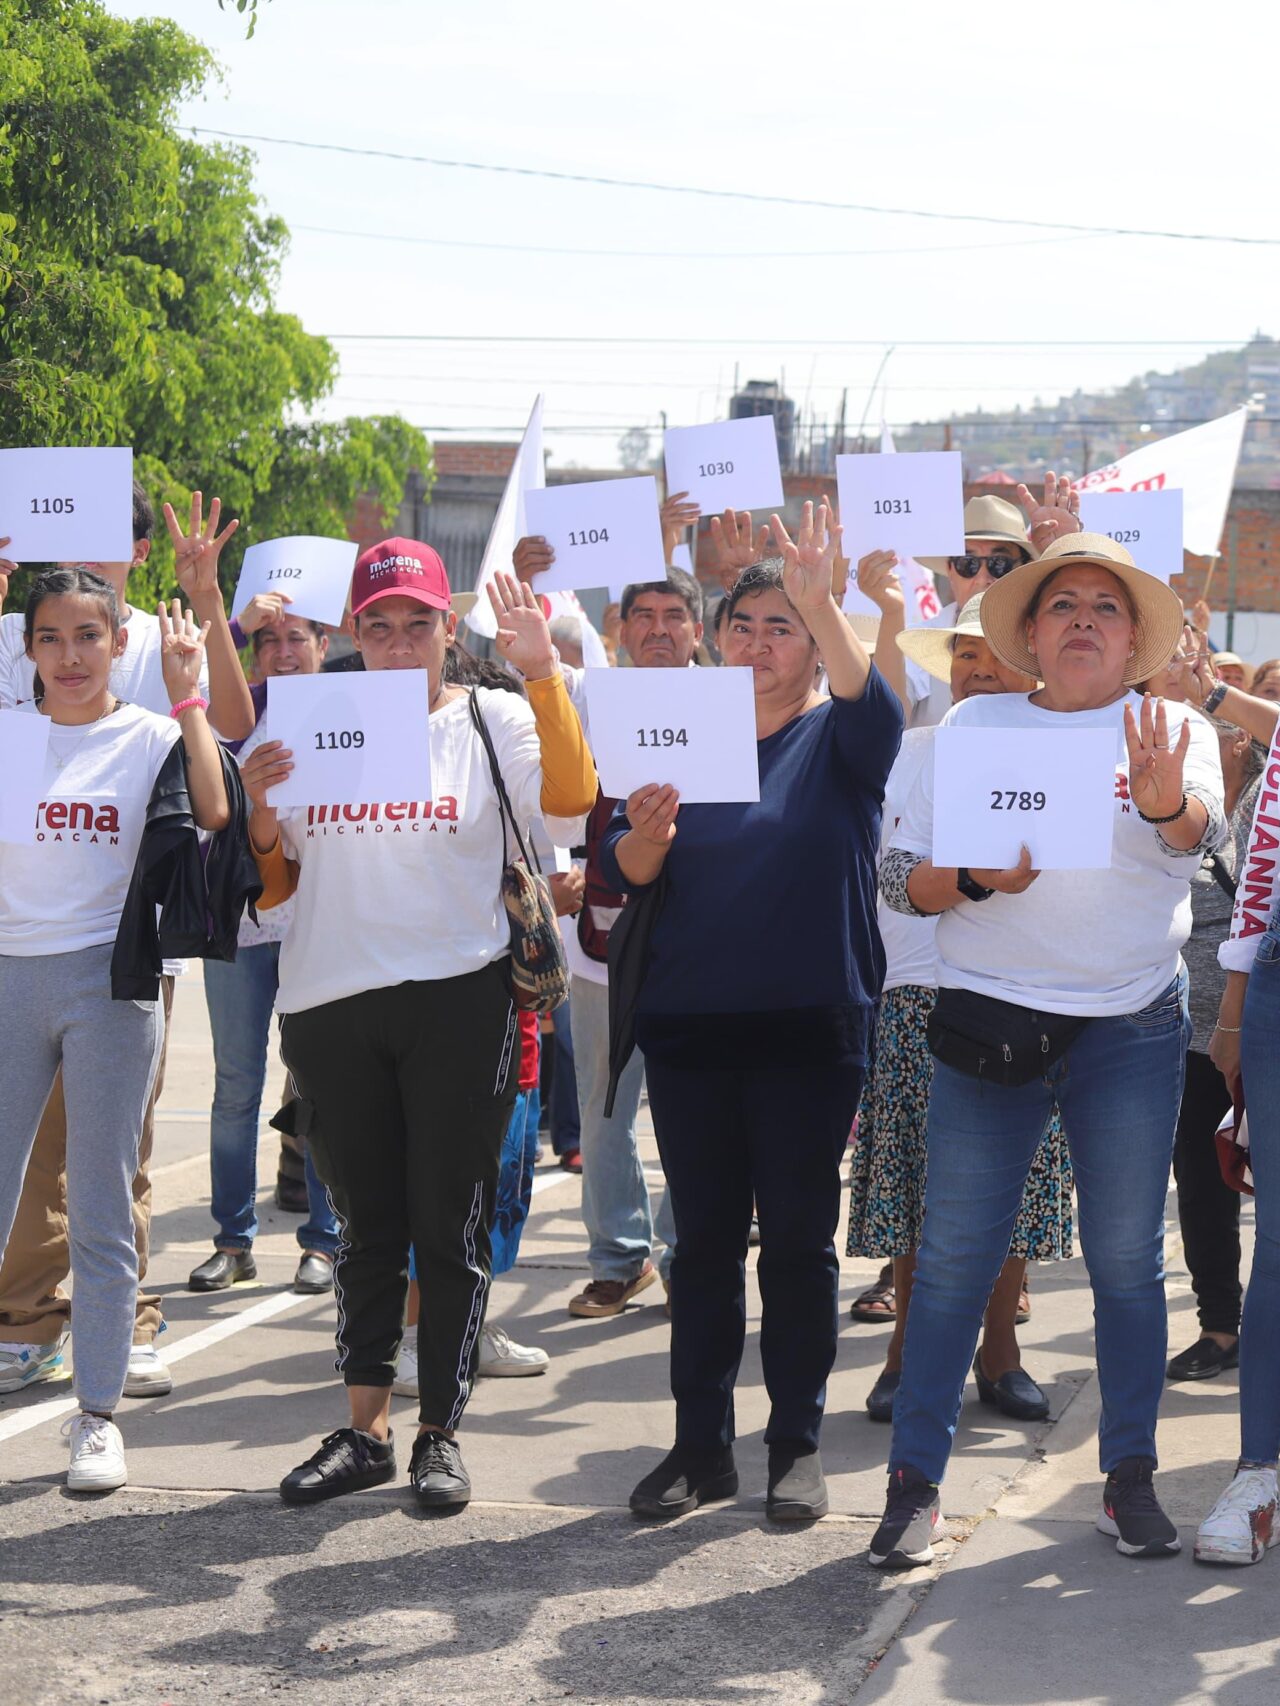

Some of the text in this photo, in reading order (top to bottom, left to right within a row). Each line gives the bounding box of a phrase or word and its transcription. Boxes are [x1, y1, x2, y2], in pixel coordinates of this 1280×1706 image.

[698, 461, 734, 478] 1030
[30, 498, 75, 514] 1105
[874, 499, 912, 515] 1031
[568, 528, 610, 546] 1104
[369, 555, 423, 574] morena
[266, 568, 302, 581] 1102
[314, 730, 365, 750] 1109
[637, 728, 689, 747] 1194
[990, 790, 1046, 811] 2789
[35, 801, 120, 832] rena
[306, 821, 458, 838] MICHOACÁN
[37, 833, 119, 845] OACÁN
